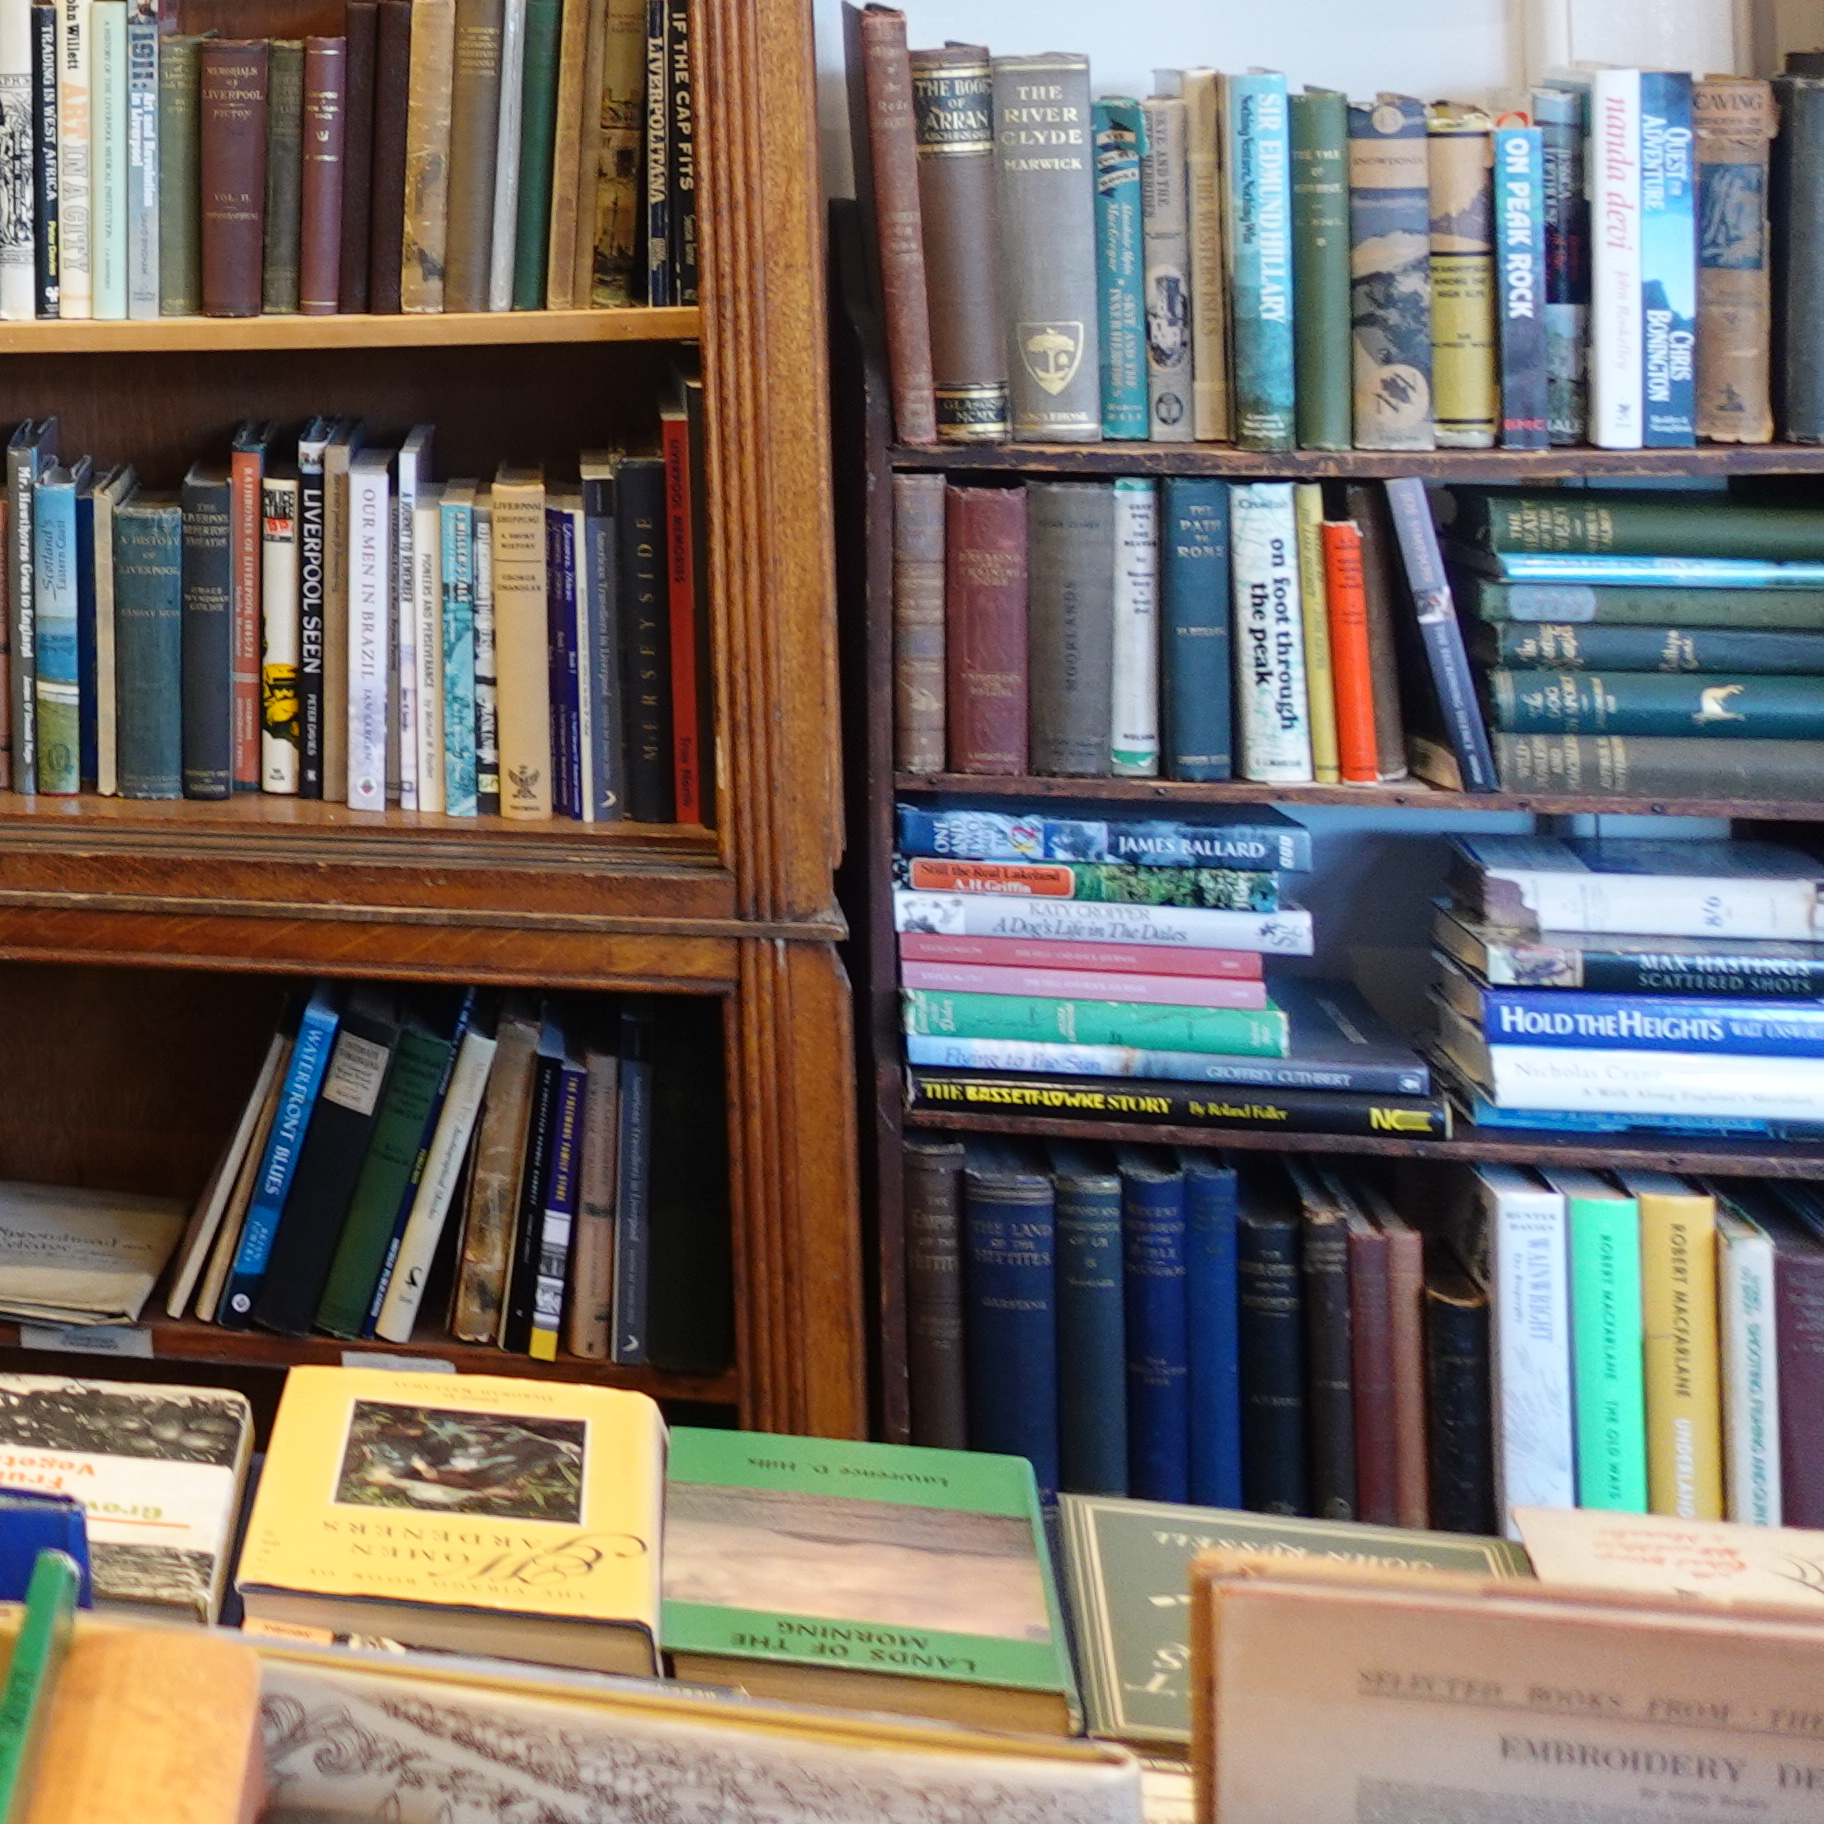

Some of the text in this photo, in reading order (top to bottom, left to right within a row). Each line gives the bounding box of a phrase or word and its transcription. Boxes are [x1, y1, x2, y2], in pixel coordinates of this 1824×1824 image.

[67, 24, 80, 70] Willett
[672, 13, 694, 191] IF THE CAP FITS
[915, 78, 950, 97] THE
[947, 97, 965, 109] OF
[1017, 85, 1063, 101] THE
[41, 26, 57, 201] TRADING WEST AFRICA
[925, 111, 988, 130] ARRAN
[1004, 106, 1079, 123] RIVER
[1001, 129, 1083, 147] CLYDE
[1665, 127, 1689, 181] QUEST
[62, 83, 89, 273] ART IN A CITY
[1004, 156, 1083, 172] MARWICK
[1604, 95, 1630, 251] nanda devi
[1640, 114, 1666, 212] ADVENTURE
[1256, 92, 1286, 323] SIR EDMUND HILLARY
[1503, 138, 1535, 320] ON PEAK ROCK
[1646, 308, 1674, 402] BONINGTON
[1669, 331, 1695, 382] CHRIS
[1503, 418, 1545, 432] BMC
[17, 466, 34, 659] Mr. Hawthorne Goes England
[302, 489, 323, 675] LIVERPOOL SEEN
[360, 488, 377, 681] OUR MEN IN BRAZIL
[1250, 583, 1273, 687] the peak
[1269, 537, 1299, 731] on foot through
[1118, 835, 1266, 859] JAMES BALLARD
[1029, 902, 1152, 921] KATY CROPPER
[1088, 924, 1104, 939] in
[1637, 973, 1812, 993] SCATTERED SHOTS
[1695, 955, 1812, 976] HASTINGS
[1500, 1004, 1724, 1041] HOLD THE HEIGHTS
[265, 1029, 323, 1197] WATERFRONT BLUES
[924, 1082, 1174, 1115] THE STORY
[1669, 1223, 1692, 1399] ROBERT MACFARLANE
[1599, 1233, 1623, 1500] ROBERT MACFARLANE THE OLD WAYS
[730, 1632, 977, 1675] LANDS OF THE
[776, 1618, 931, 1649] MORNING
[1526, 1683, 1732, 1724] BOOKS FROM
[1498, 1732, 1748, 1784] EMBROIDERY
